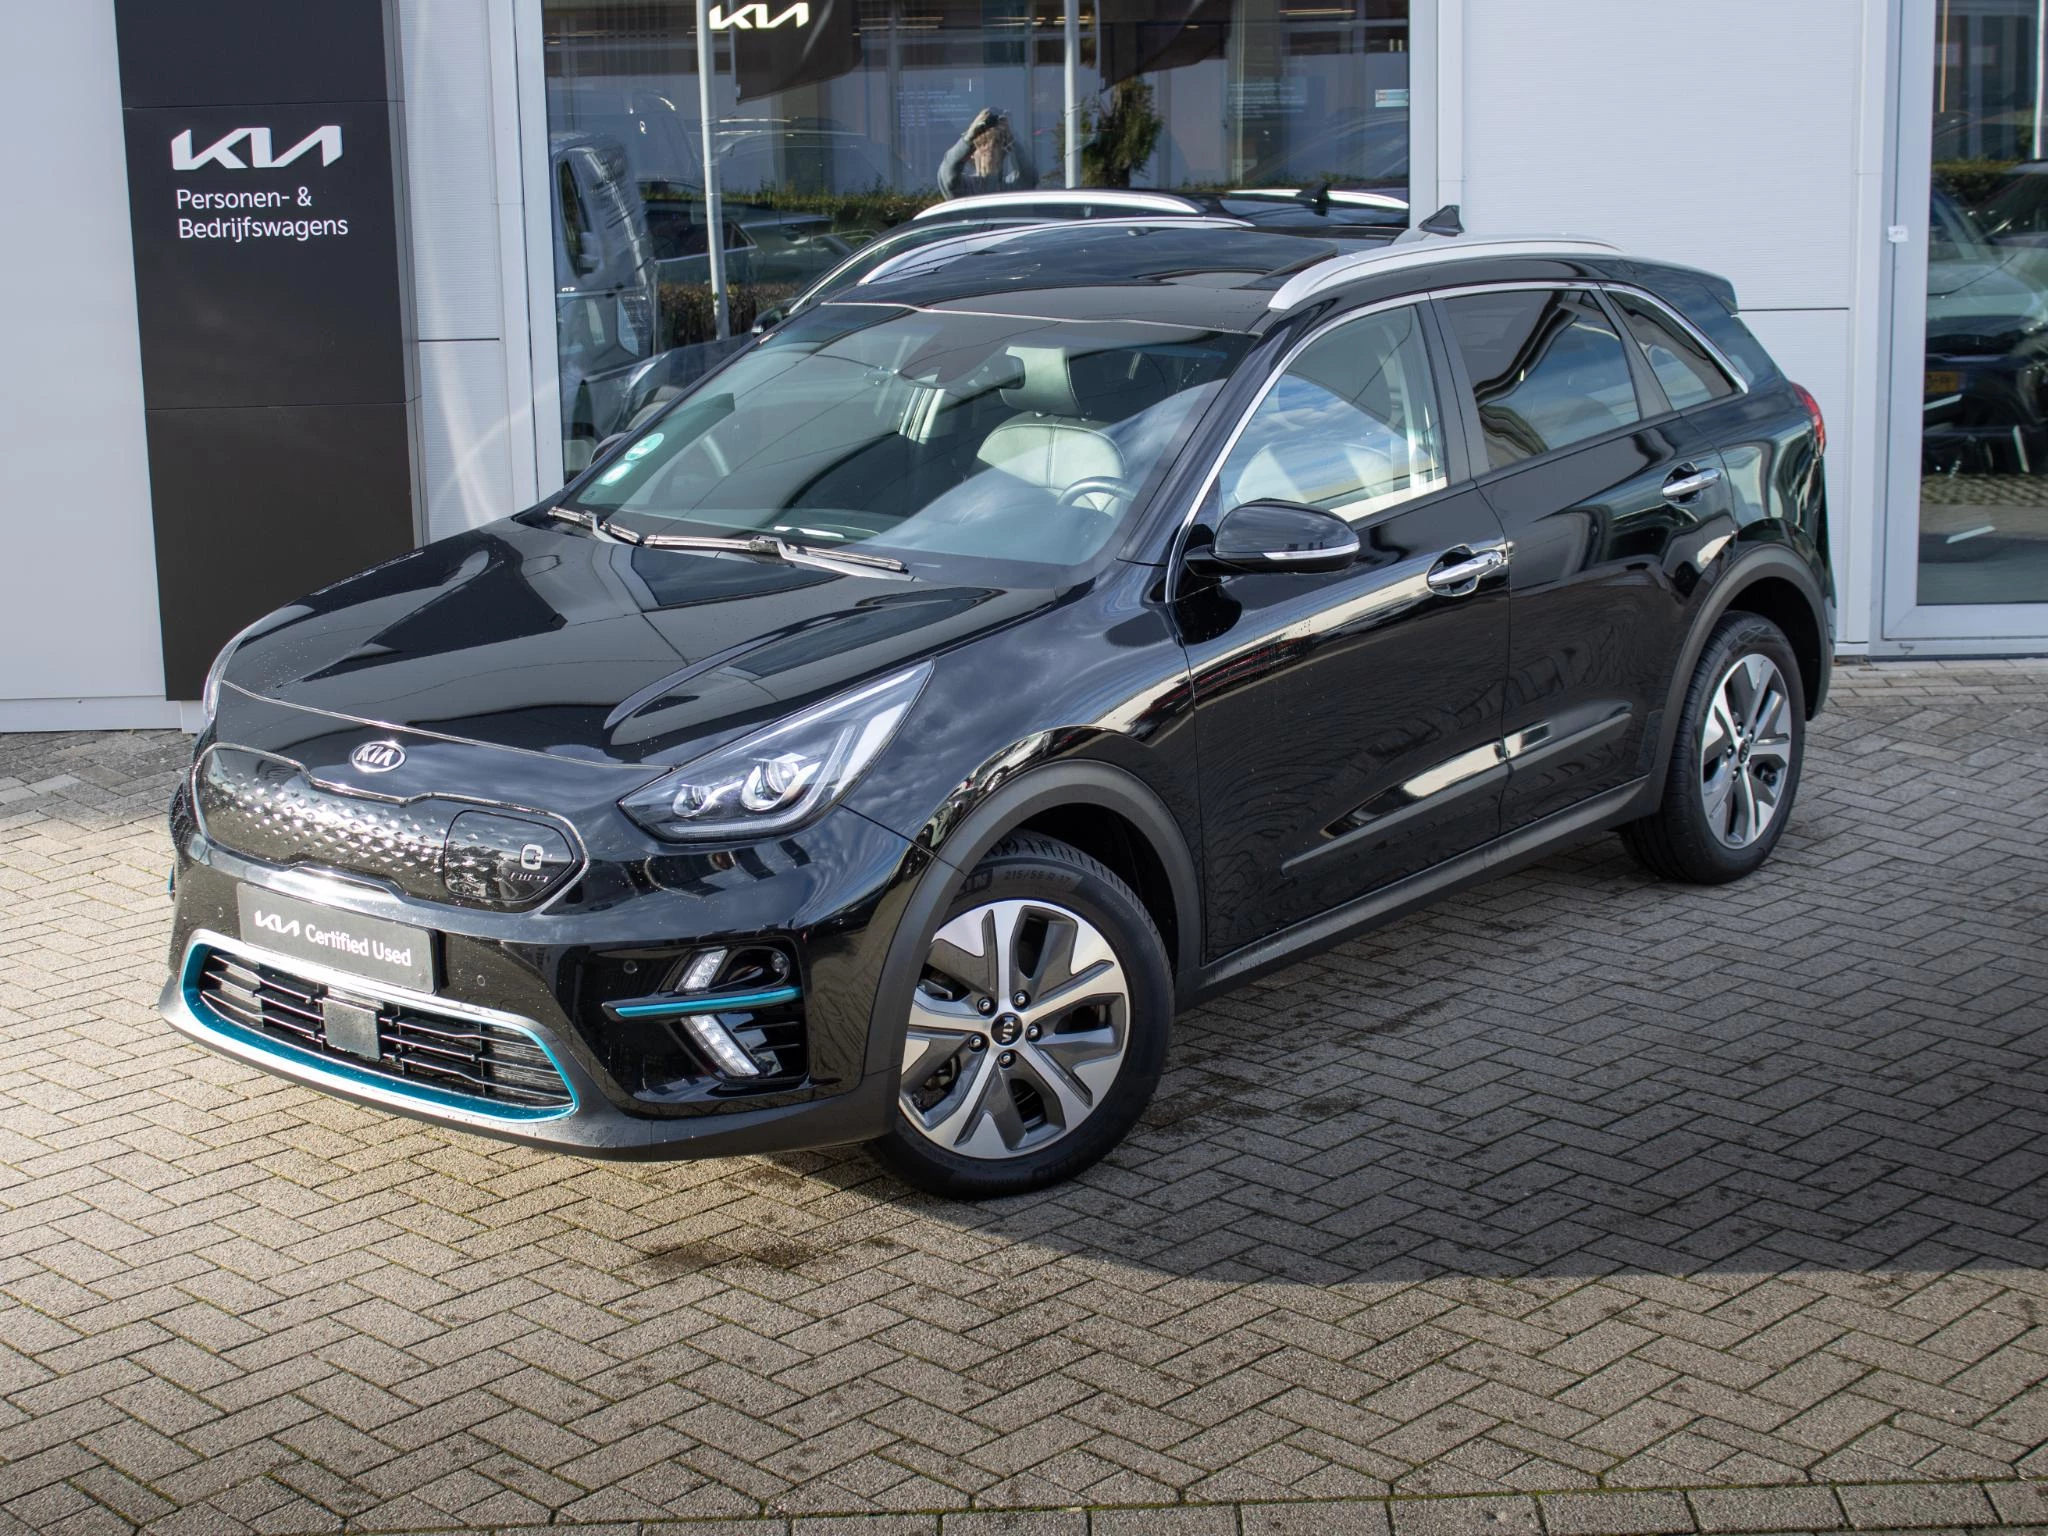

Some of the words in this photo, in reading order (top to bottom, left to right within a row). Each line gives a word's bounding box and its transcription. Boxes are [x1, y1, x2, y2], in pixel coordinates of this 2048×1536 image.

[709, 2, 809, 30] KIA
[171, 125, 343, 170] KIA
[176, 188, 290, 210] Personen-
[297, 186, 312, 207] &
[178, 216, 349, 243] Bedrijfswagens
[355, 745, 395, 767] KIA
[254, 910, 300, 937] KIA
[305, 924, 369, 957] Certified
[372, 940, 412, 967] Used
[1001, 1016, 1015, 1044] KIA
